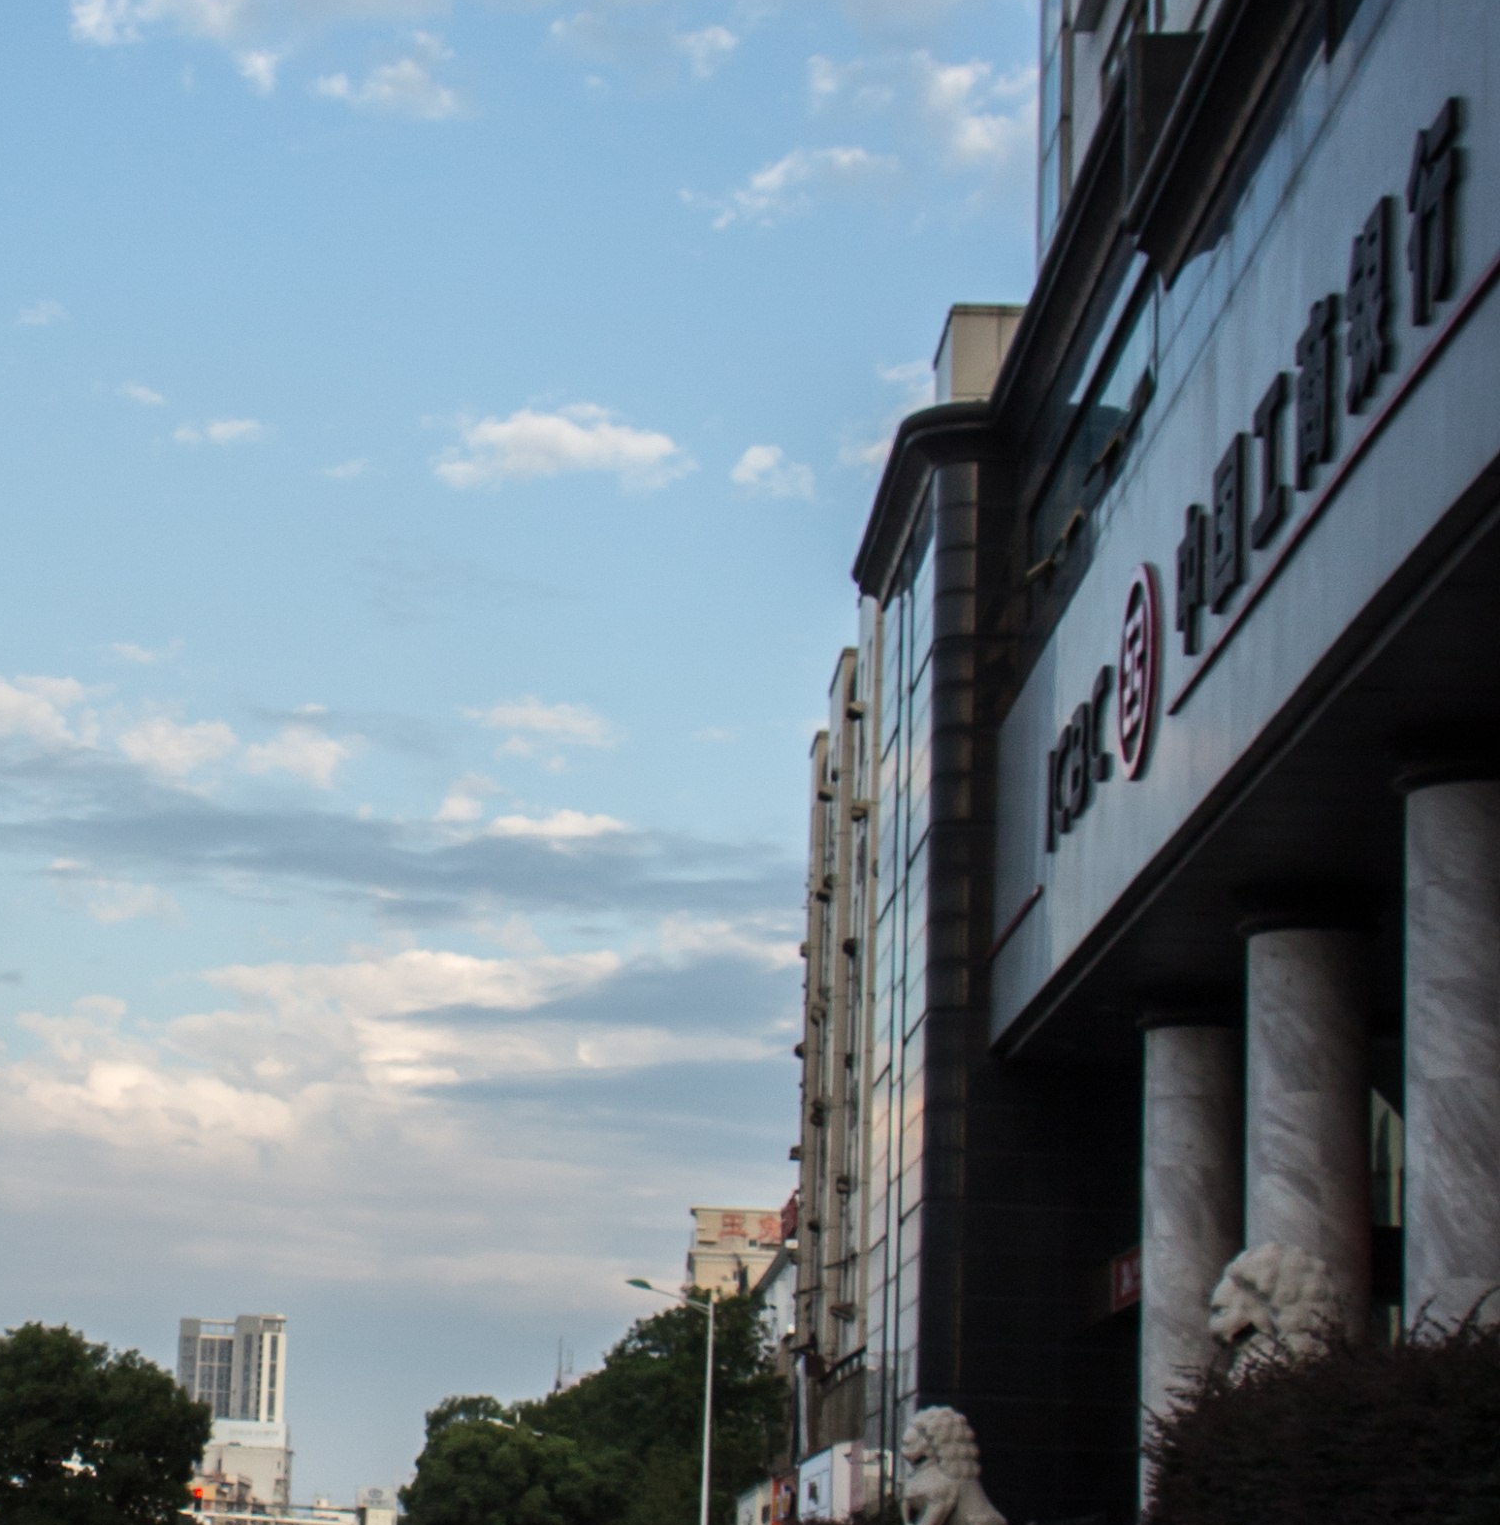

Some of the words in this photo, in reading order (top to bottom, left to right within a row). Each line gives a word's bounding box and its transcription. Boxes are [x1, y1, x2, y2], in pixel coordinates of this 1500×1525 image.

[1176, 96, 1465, 656] 中国工商银行
[1045, 664, 1116, 854] ICBC
